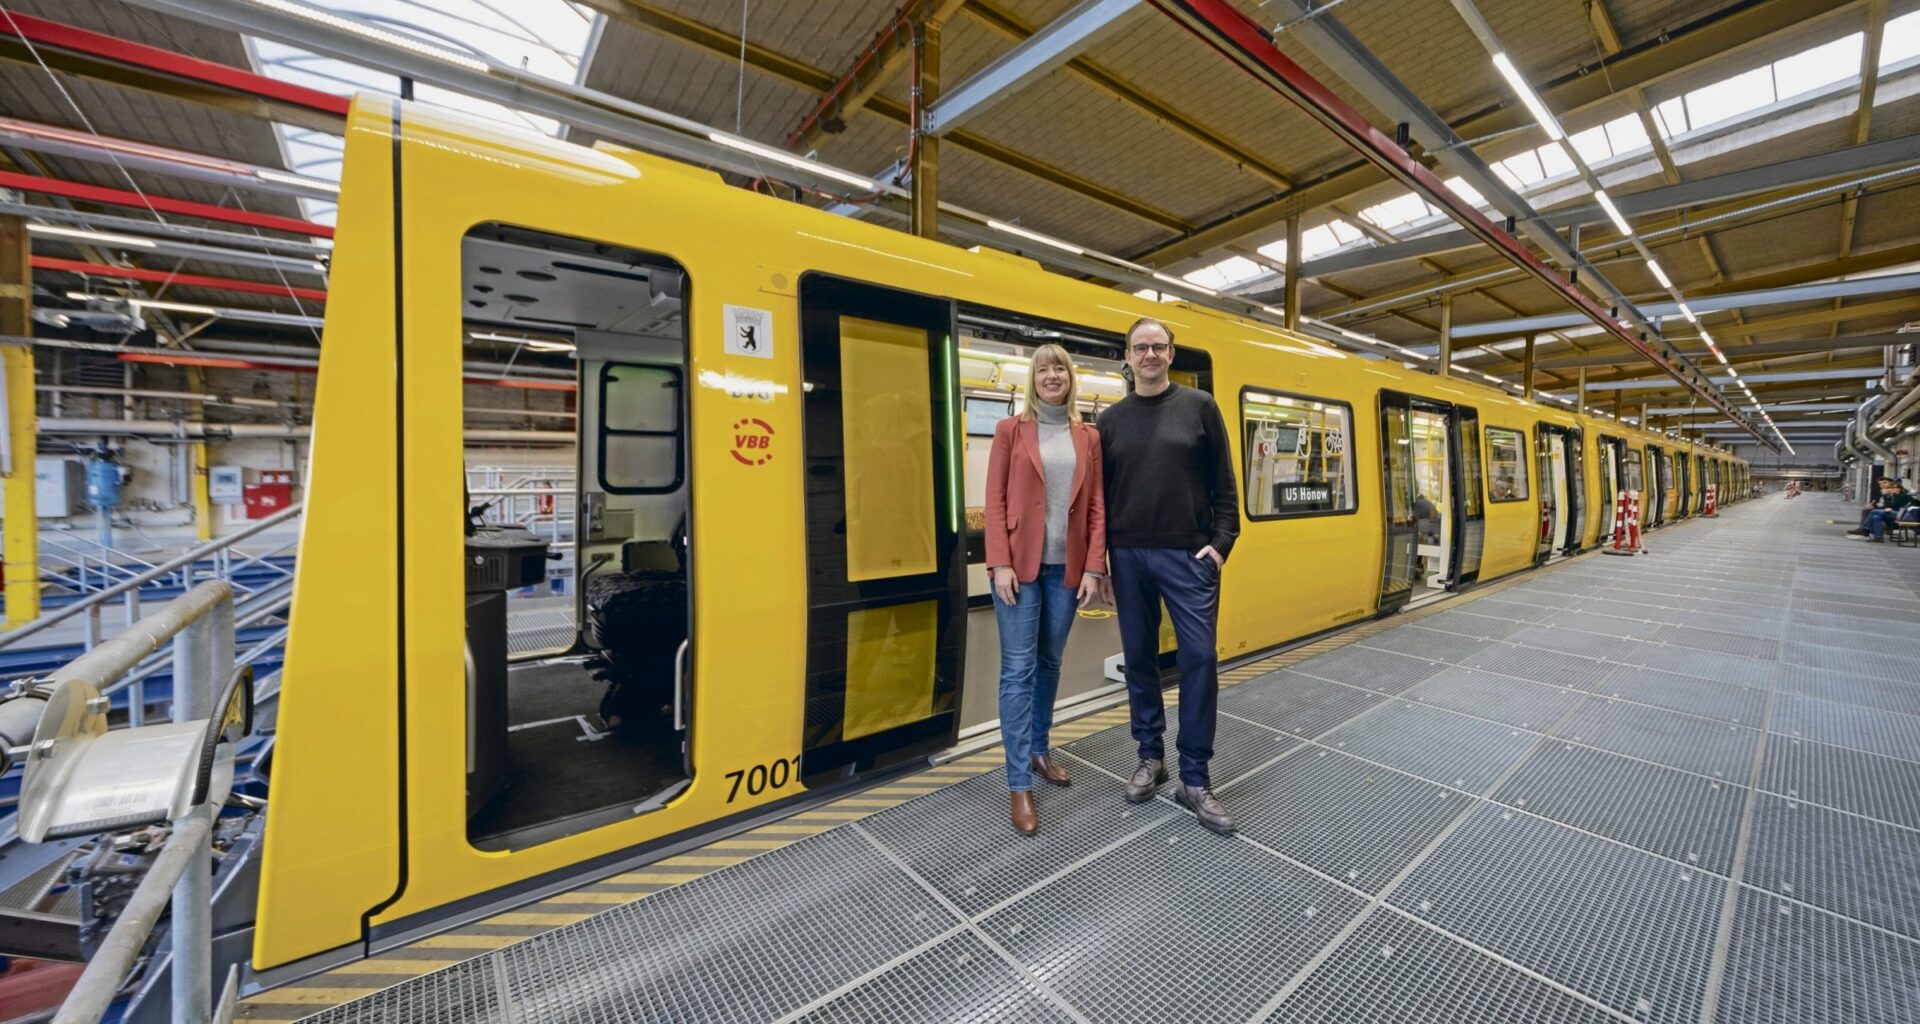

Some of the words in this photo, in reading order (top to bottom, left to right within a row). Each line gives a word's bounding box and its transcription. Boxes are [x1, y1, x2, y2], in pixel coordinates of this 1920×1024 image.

[736, 435, 770, 449] VBB
[1285, 487, 1298, 501] U5
[1300, 486, 1328, 500] Hönow
[724, 753, 801, 804] 7001
